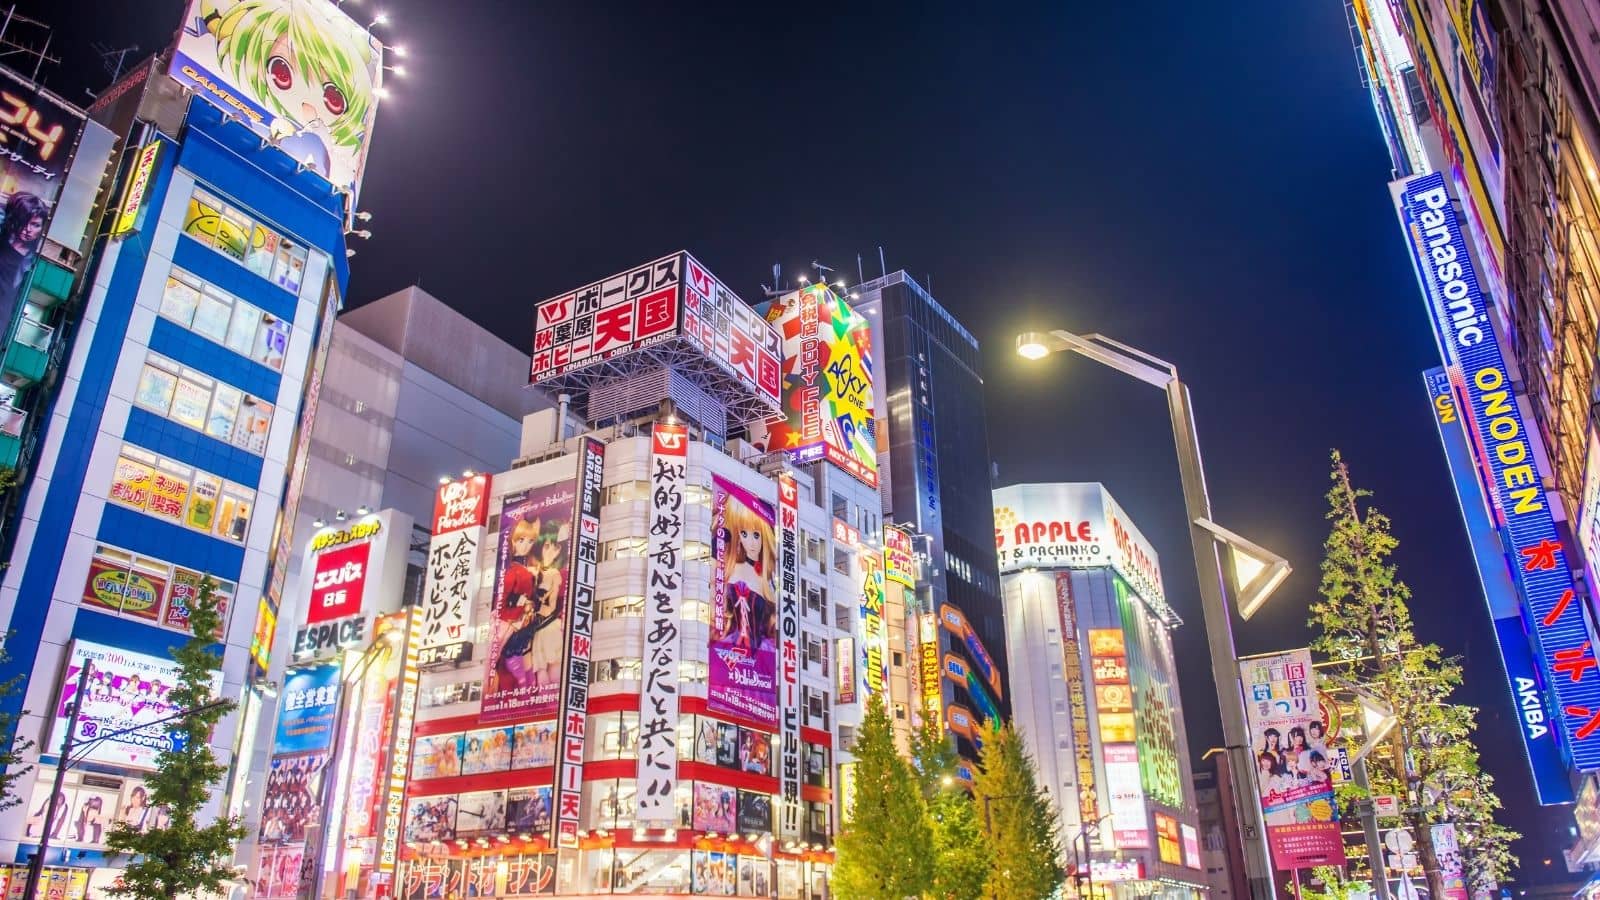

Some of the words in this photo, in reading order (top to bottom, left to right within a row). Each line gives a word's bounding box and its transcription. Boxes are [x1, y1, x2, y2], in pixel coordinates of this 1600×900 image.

[182, 65, 264, 122] GAMERS
[577, 257, 679, 313] ボークス
[1414, 187, 1483, 347] Panasonic
[535, 315, 592, 351] 秋葉原
[594, 287, 677, 345] 天国
[684, 314, 728, 354] ホビー
[685, 288, 730, 337] 秋葉原
[715, 289, 782, 360] ボークス
[532, 342, 592, 374] ホビー
[730, 325, 780, 401] 天国
[801, 386, 821, 440] FREE
[848, 393, 865, 410] ONE
[1474, 367, 1543, 515] ONODEN
[314, 561, 363, 590] エスパス
[1013, 548, 1023, 559] &
[1029, 544, 1101, 557] PACHINKO
[294, 617, 365, 654] ESPACE
[1520, 539, 1600, 739] オノデン
[1258, 698, 1307, 717] まつり
[1515, 676, 1548, 740] AKIBA
[101, 728, 172, 751] maidreamin
